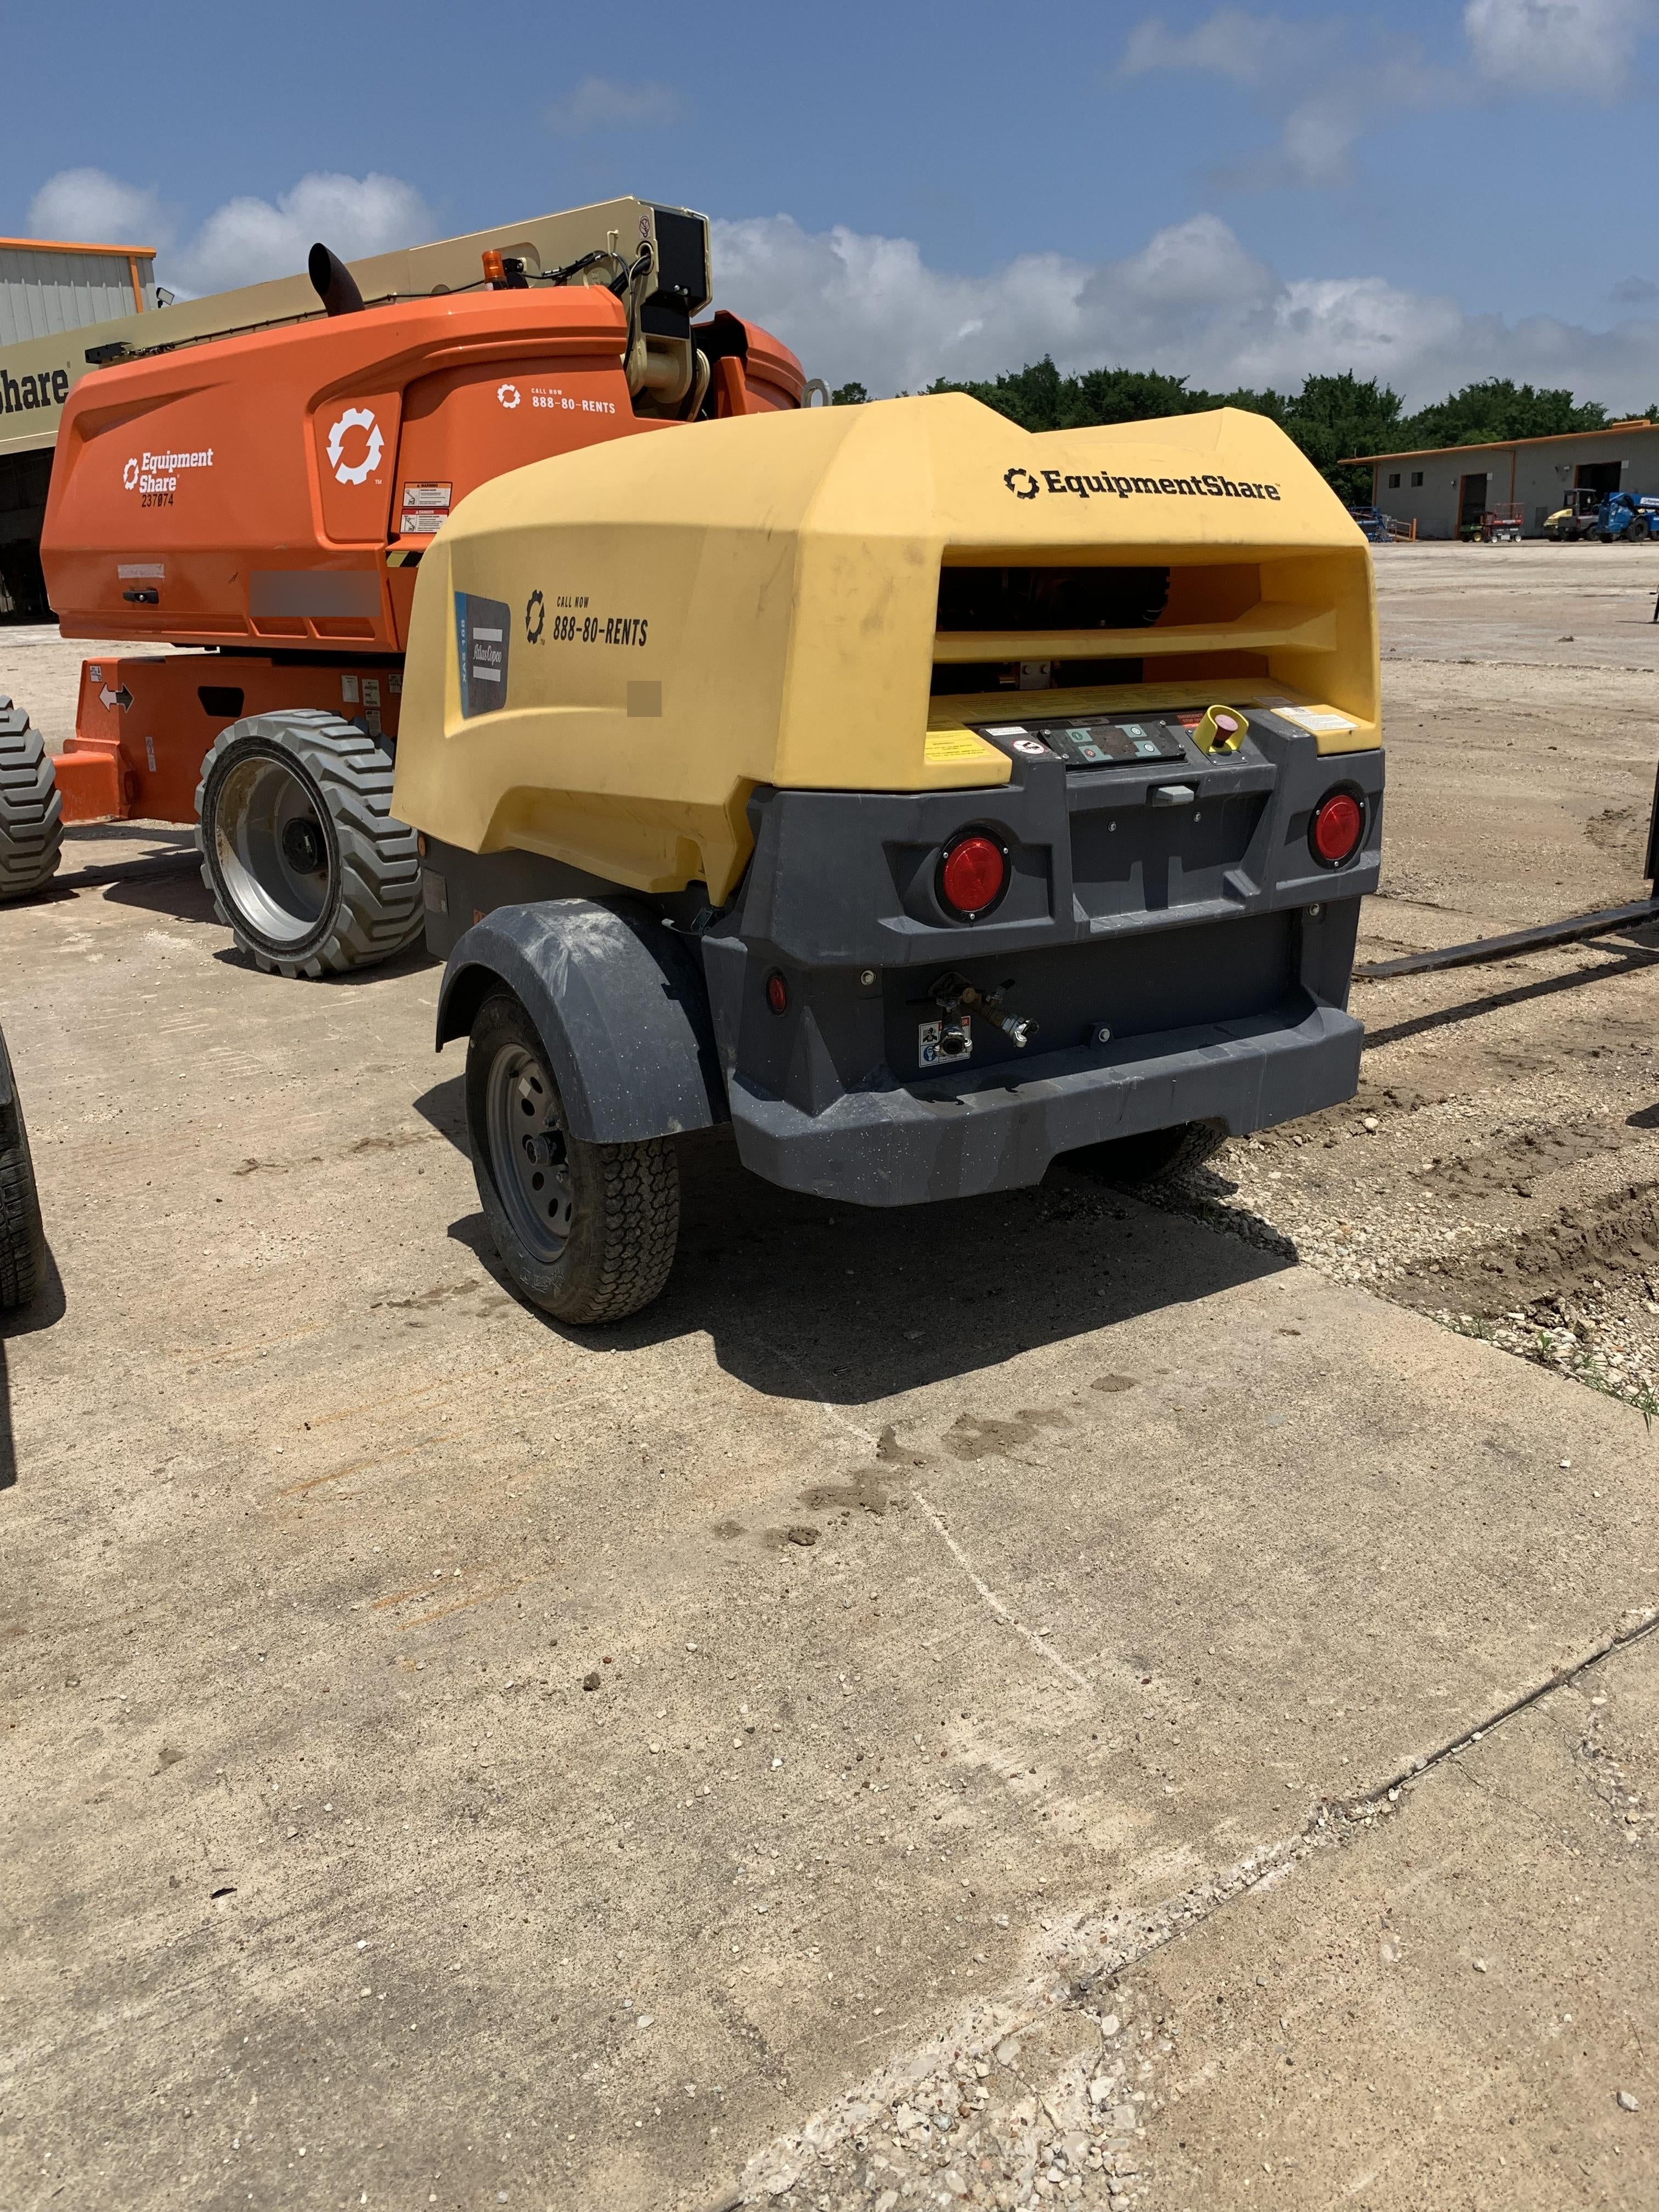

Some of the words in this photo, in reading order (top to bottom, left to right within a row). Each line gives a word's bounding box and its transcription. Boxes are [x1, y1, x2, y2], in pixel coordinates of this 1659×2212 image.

[0, 369, 69, 414] hare
[532, 396, 616, 414] 888-80-RENTS
[141, 448, 213, 474] Equipment
[139, 474, 177, 493] Share
[1040, 470, 1280, 501] EquipmentShare
[142, 494, 174, 508] 237074
[557, 596, 572, 608] CALL
[574, 597, 589, 608] NOW
[553, 616, 648, 646] 888-80-RENTS
